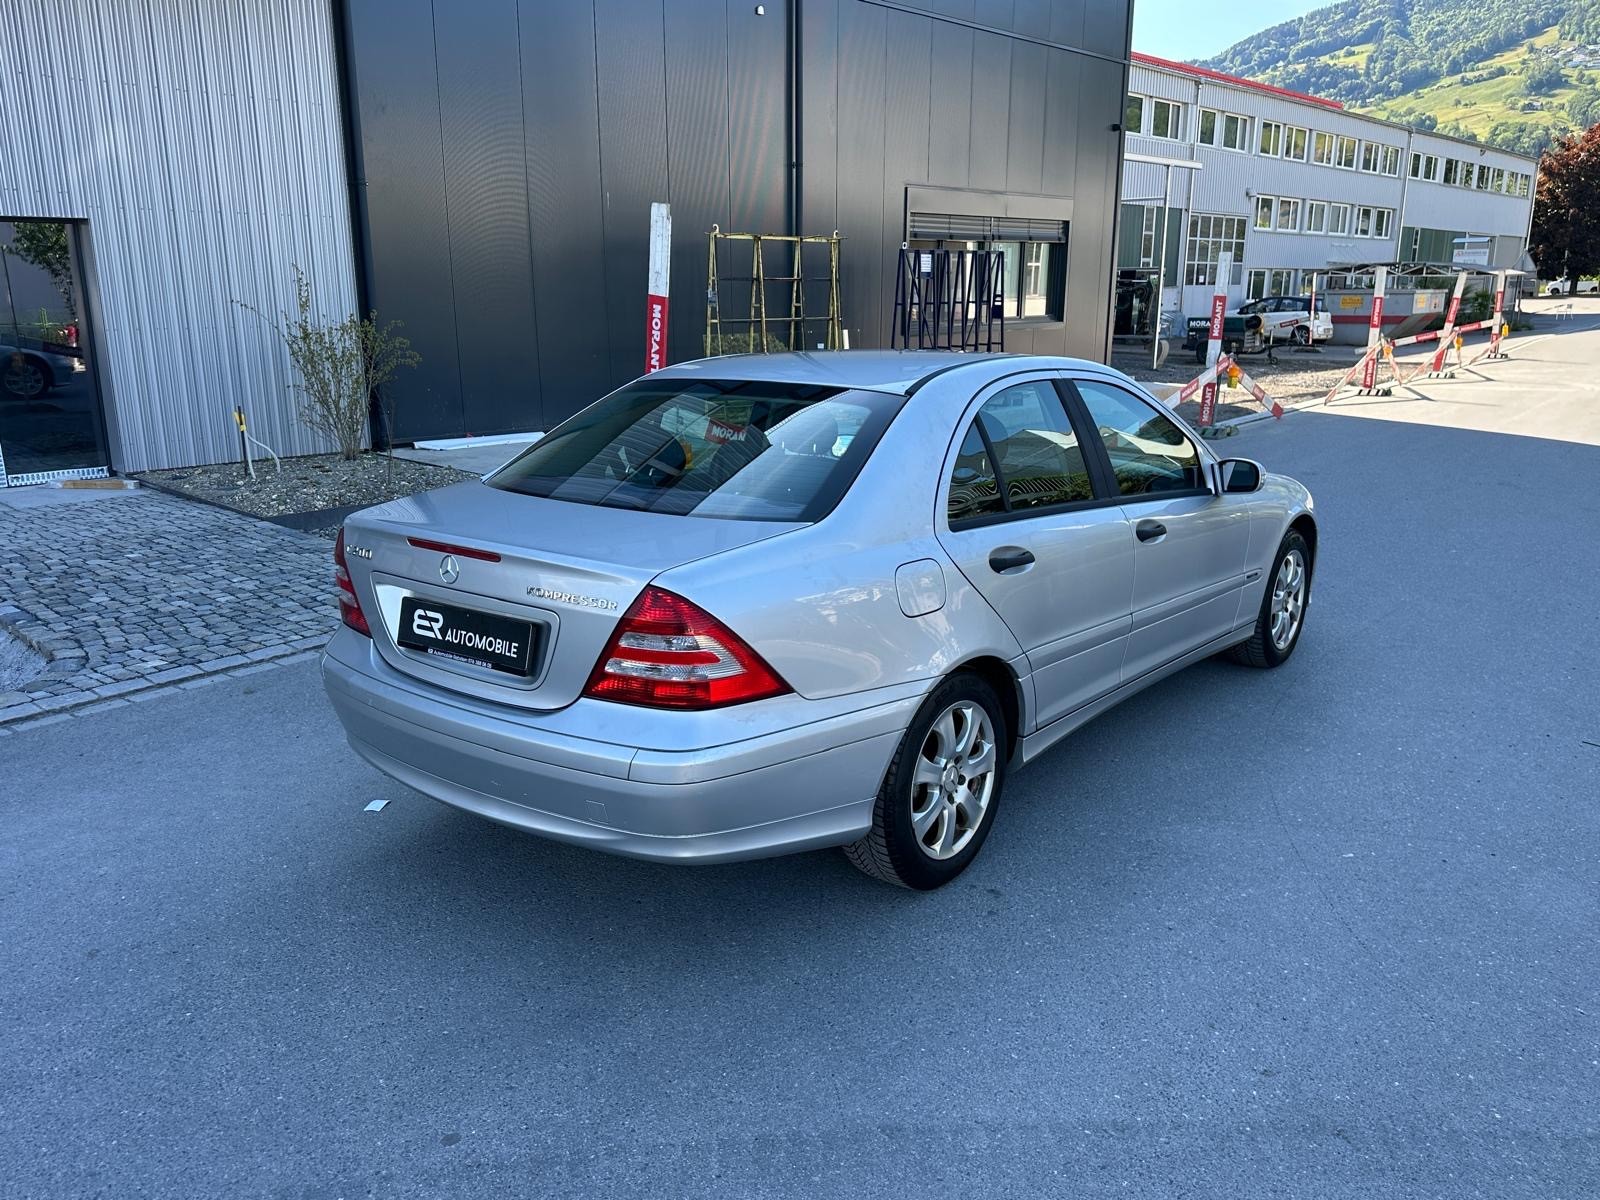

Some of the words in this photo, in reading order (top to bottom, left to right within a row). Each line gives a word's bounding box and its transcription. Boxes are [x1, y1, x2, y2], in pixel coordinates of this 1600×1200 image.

[1190, 319, 1211, 327] MORA
[1212, 300, 1223, 336] MORANT
[651, 304, 662, 373] MORANT
[1202, 387, 1213, 422] MORANT
[711, 424, 747, 441] MORAN
[526, 585, 618, 610] KOMPRESSOR
[413, 608, 443, 640] ER
[445, 628, 519, 658] AUTOMOBILE
